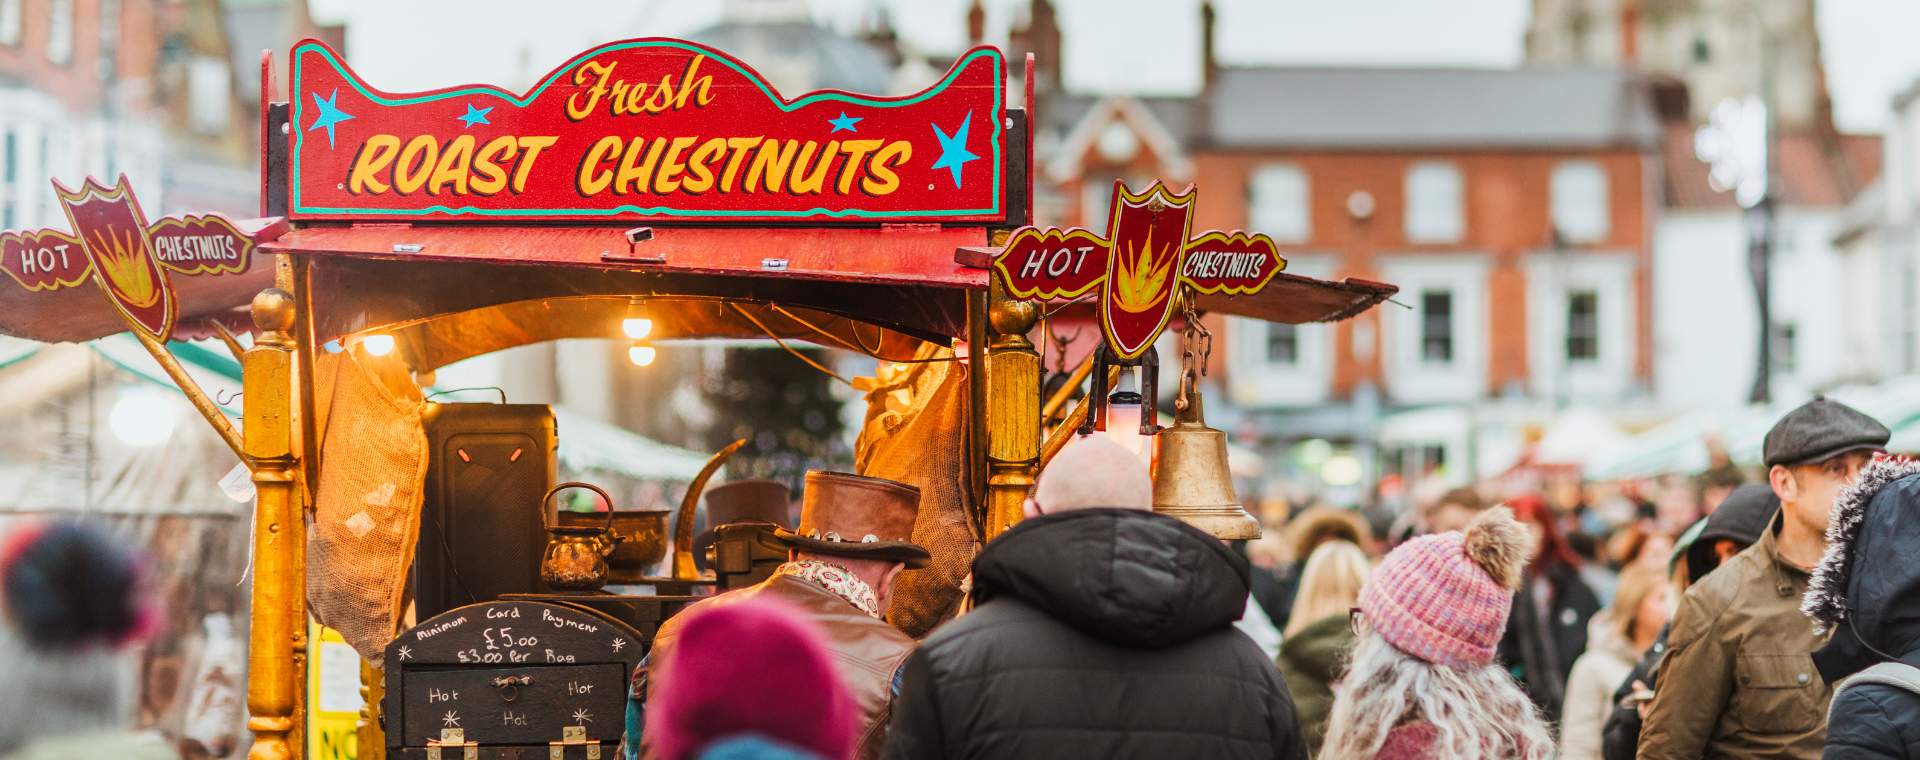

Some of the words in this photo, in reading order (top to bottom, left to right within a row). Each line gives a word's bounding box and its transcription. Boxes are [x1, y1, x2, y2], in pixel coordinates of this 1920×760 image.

[565, 54, 716, 122] Fresh
[347, 134, 559, 197] ROAST
[575, 136, 912, 197] CHESTNUTS
[21, 244, 69, 274] HOT
[155, 235, 238, 261] CHESTNUTS
[1021, 246, 1095, 279] HOT
[1182, 251, 1267, 279] CHESTNUTS
[486, 607, 520, 619] Card
[543, 609, 598, 632] Payment
[483, 627, 538, 650] £5.00
[457, 649, 503, 663] £3.00
[510, 650, 531, 662] Per
[429, 688, 459, 703] Hot
[567, 681, 594, 696] Hot
[503, 711, 528, 726] Hot
